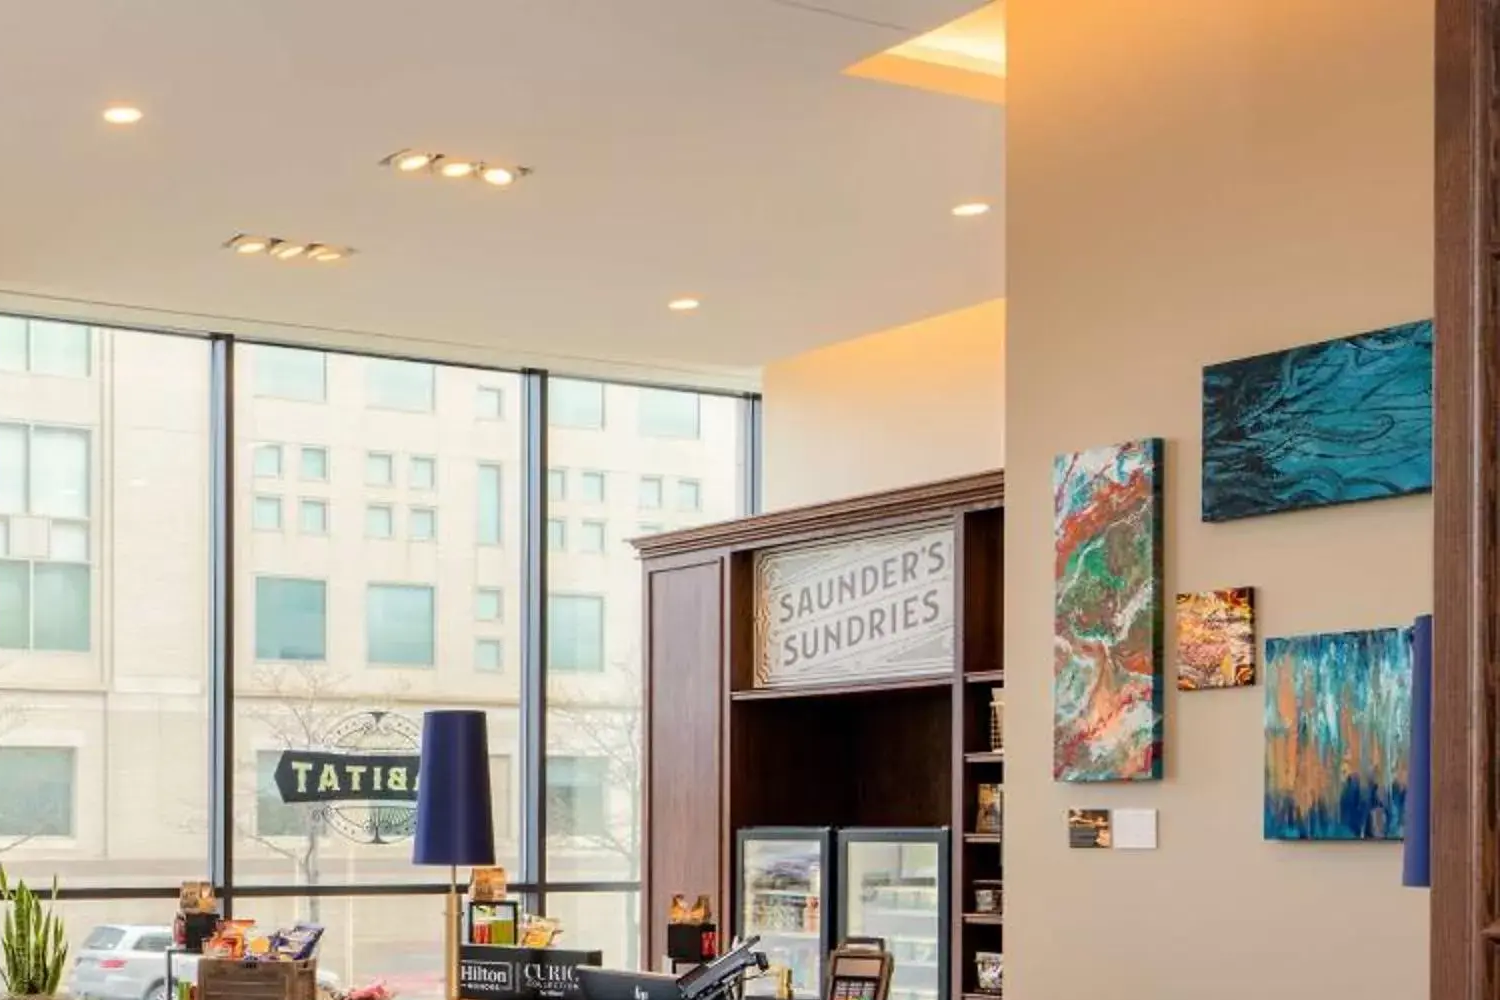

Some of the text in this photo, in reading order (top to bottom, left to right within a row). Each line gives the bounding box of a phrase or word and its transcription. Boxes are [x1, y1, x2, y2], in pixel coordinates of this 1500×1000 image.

[779, 541, 946, 624] SAUNDER'S
[783, 589, 940, 667] SUNDRIES
[461, 964, 506, 983] Hilton
